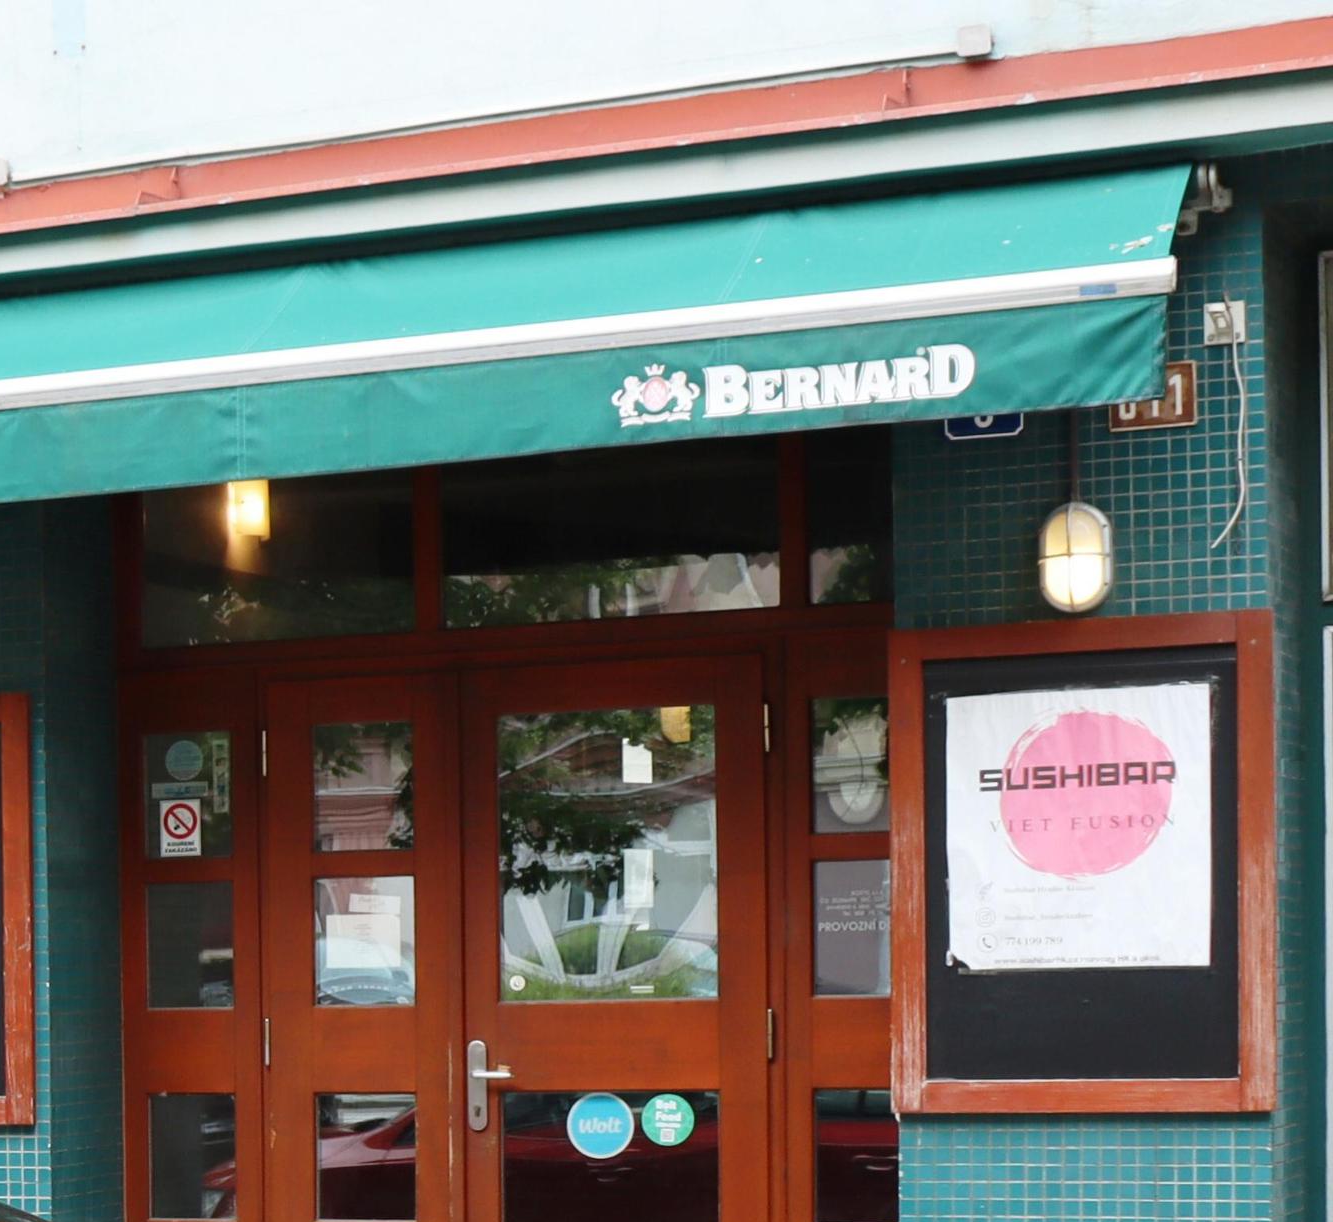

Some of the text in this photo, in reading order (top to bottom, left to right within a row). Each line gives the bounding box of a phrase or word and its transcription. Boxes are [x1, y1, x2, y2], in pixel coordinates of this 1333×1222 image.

[703, 344, 976, 418] BERNARD
[979, 760, 1177, 792] SUSHIBAR
[989, 813, 1176, 834] VIET FUSION
[818, 918, 876, 932] PROVOZNÍ
[579, 1117, 623, 1134] Wolt
[654, 1111, 682, 1122] Food
